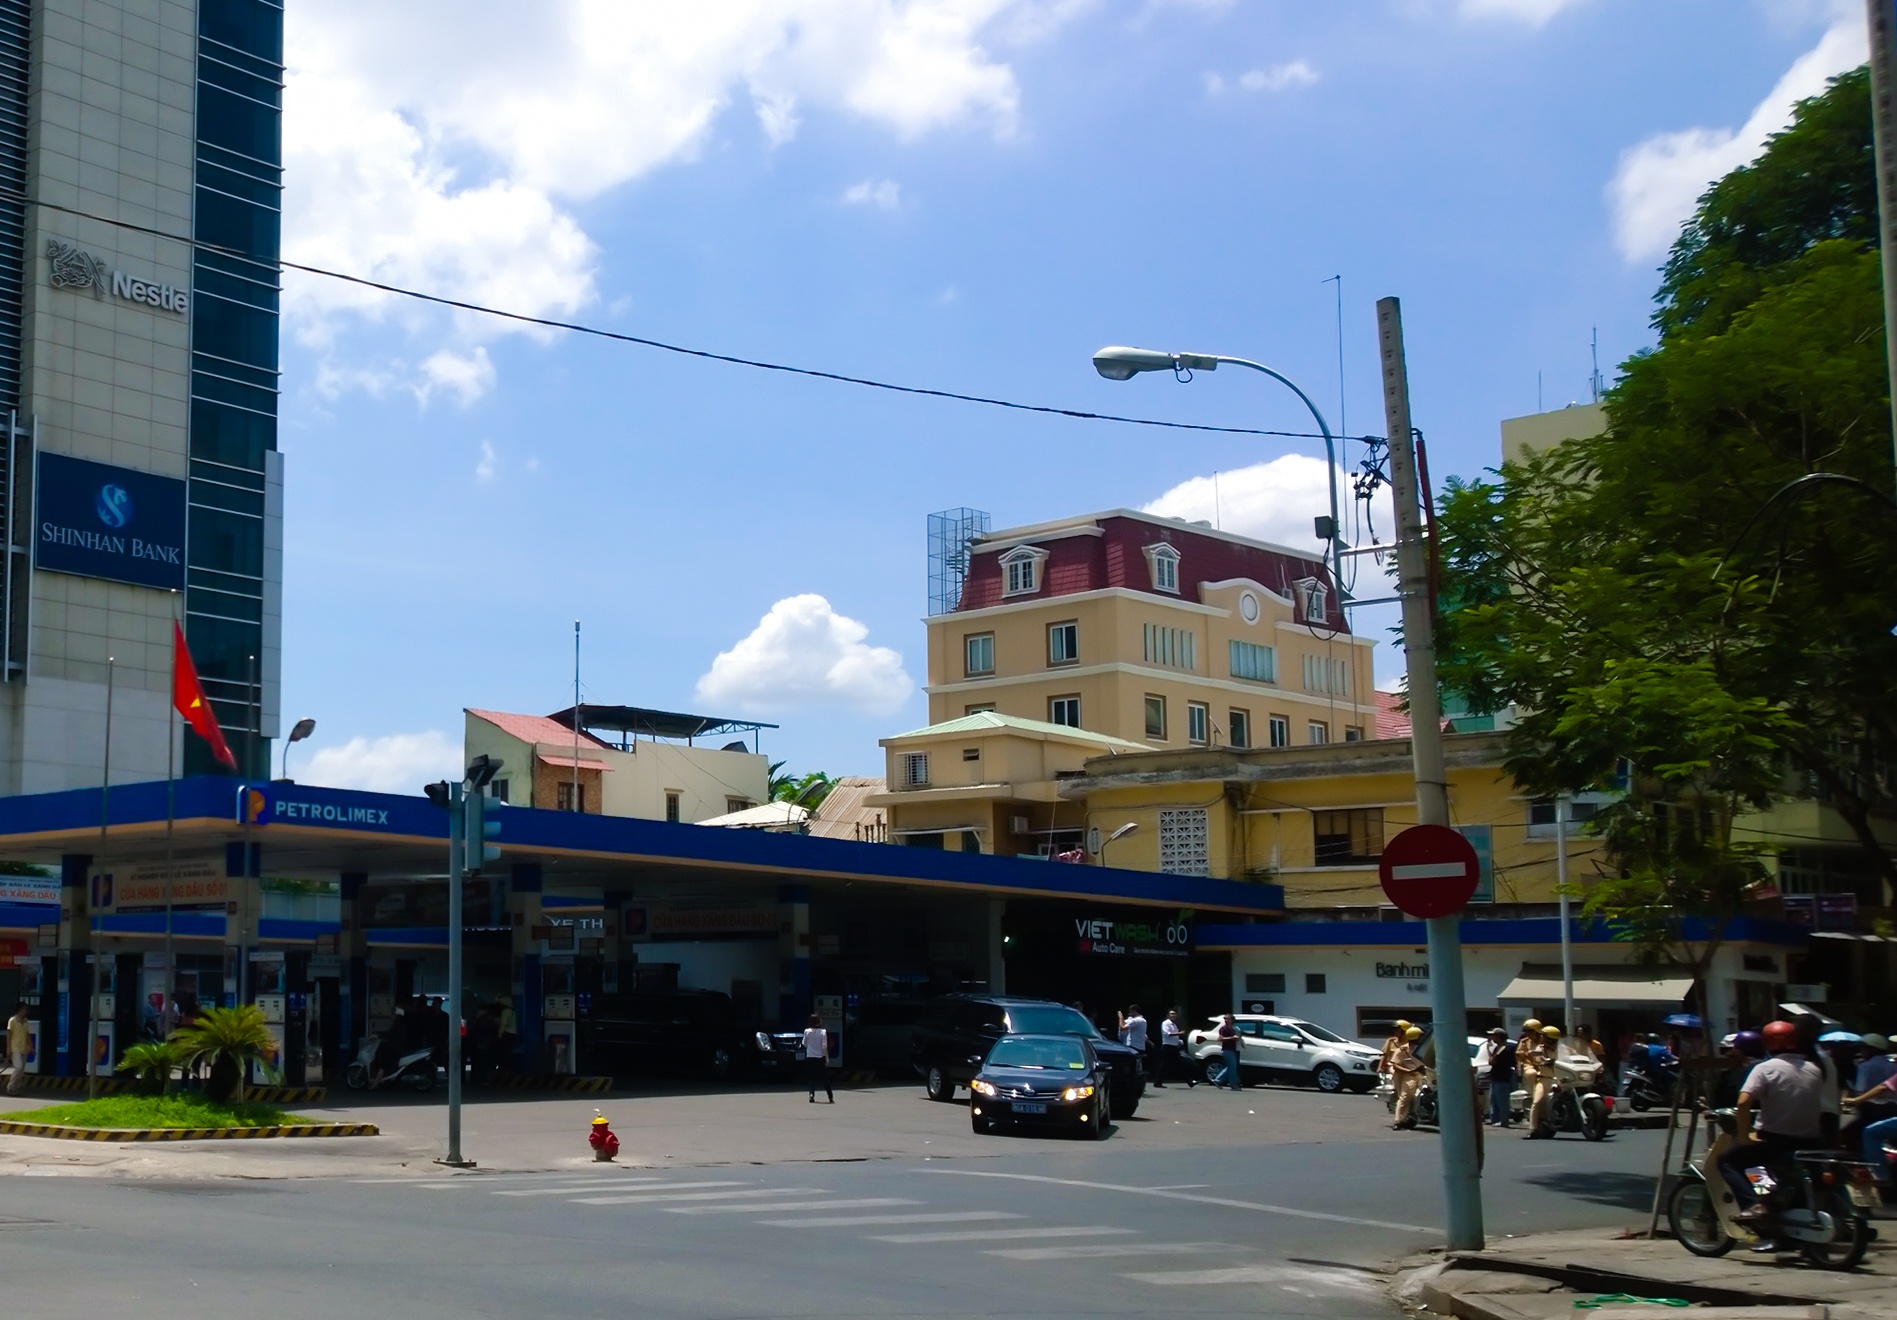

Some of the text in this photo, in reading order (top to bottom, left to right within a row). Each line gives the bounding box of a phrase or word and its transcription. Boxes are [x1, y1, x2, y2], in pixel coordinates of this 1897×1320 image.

[42, 522, 180, 564] SHINHAN BANK
[275, 799, 389, 825] PETROLIMEX
[1092, 941, 1109, 953] Auto
[1109, 943, 1126, 954] Care
